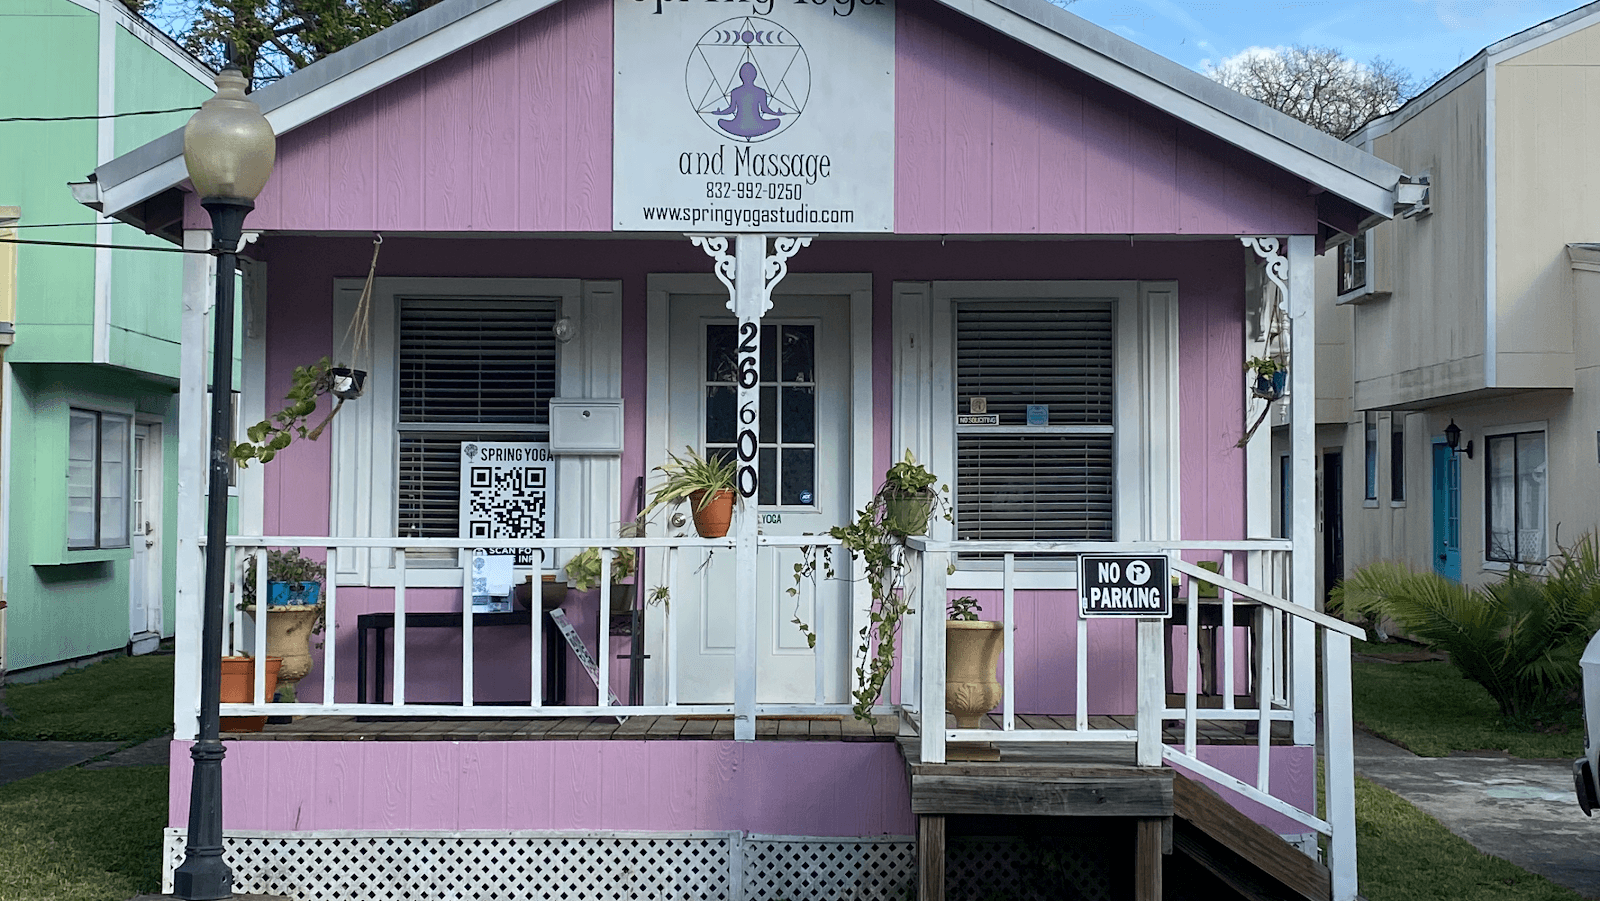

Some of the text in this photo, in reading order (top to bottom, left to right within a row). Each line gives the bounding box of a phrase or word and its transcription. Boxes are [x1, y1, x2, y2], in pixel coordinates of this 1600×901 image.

[679, 144, 831, 185] and Massage
[706, 181, 802, 200] 832-992-0250
[643, 202, 854, 227] www.springyogastudio.com
[481, 448, 554, 461] SPRING YOGA
[1098, 562, 1120, 583] NO
[1090, 587, 1160, 609] PARKING
